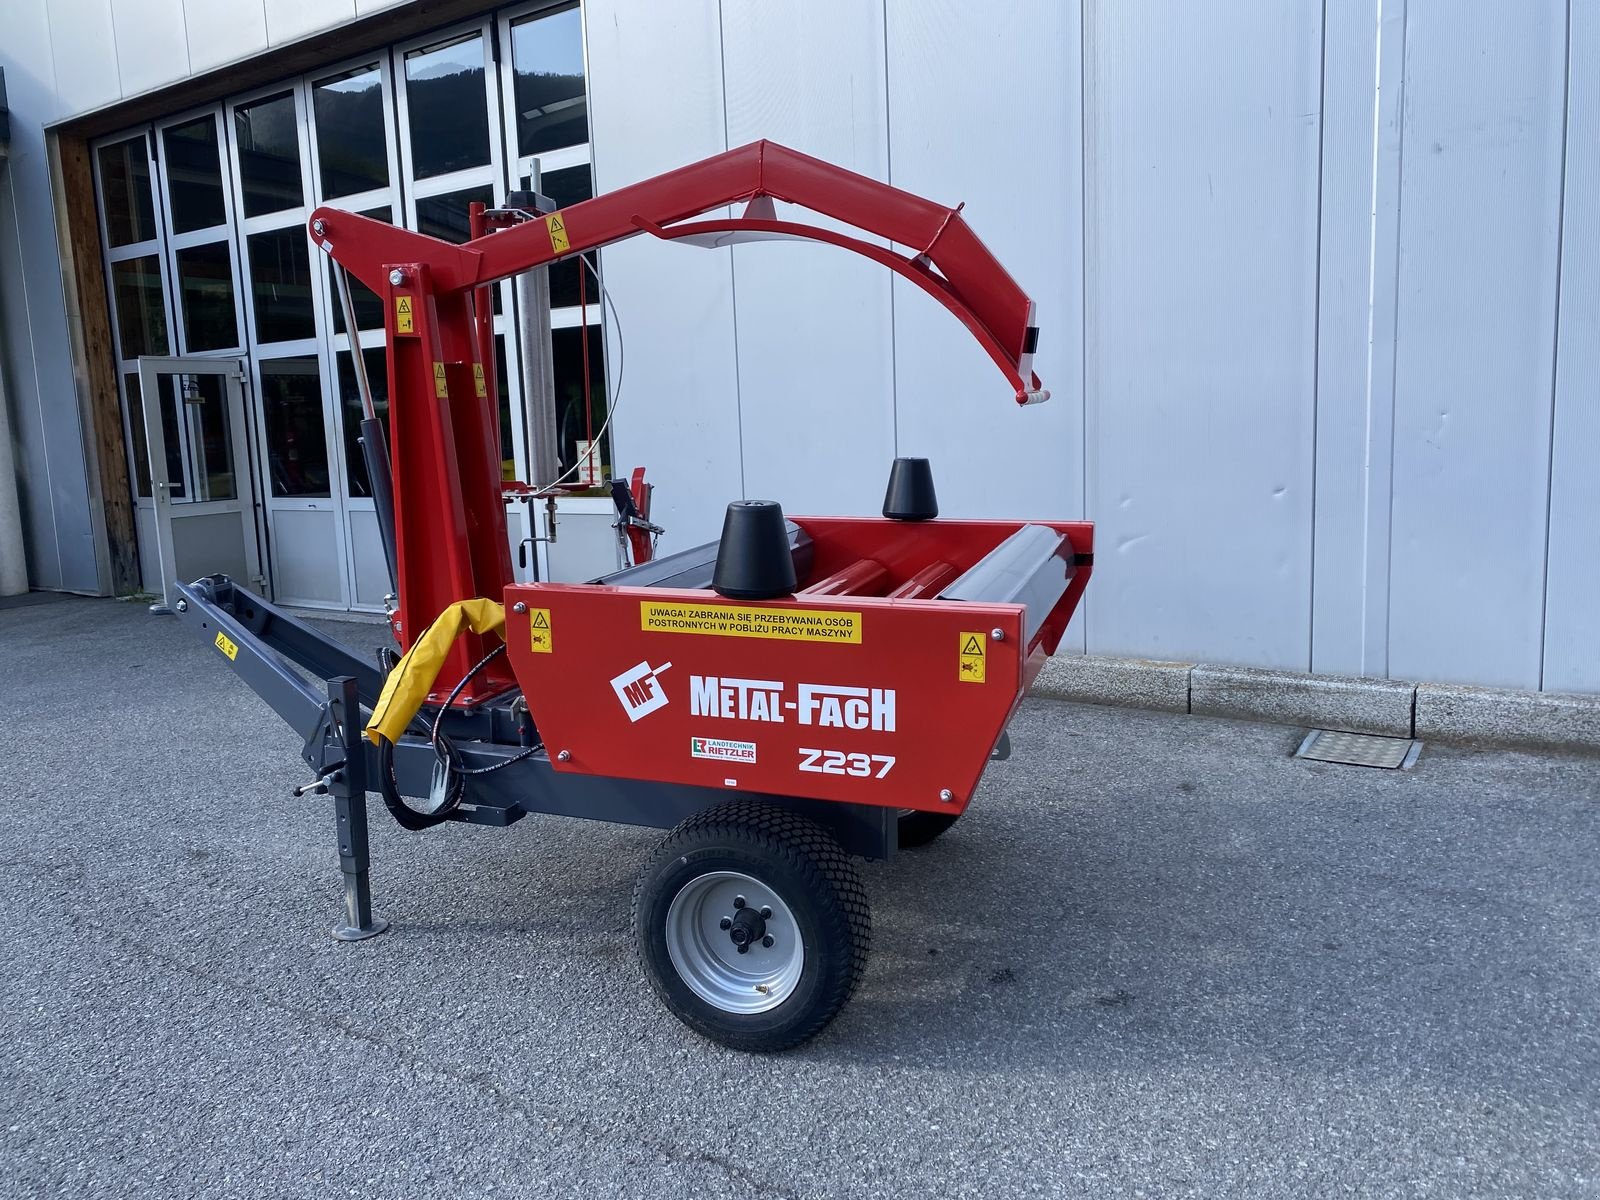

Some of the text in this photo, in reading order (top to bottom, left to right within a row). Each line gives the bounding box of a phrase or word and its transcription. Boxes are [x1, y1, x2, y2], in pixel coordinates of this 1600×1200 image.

[650, 608, 853, 628] UWAGA! ZABRANIA SIĘ PRZEBYWANIA OSÓB
[648, 618, 853, 639] POSTRONNYCH W POBLIŻU PRACY MASZYNY
[707, 740, 755, 750] LANDTECHNIK
[708, 746, 755, 759] RIETZLER
[798, 747, 896, 779] Z237
